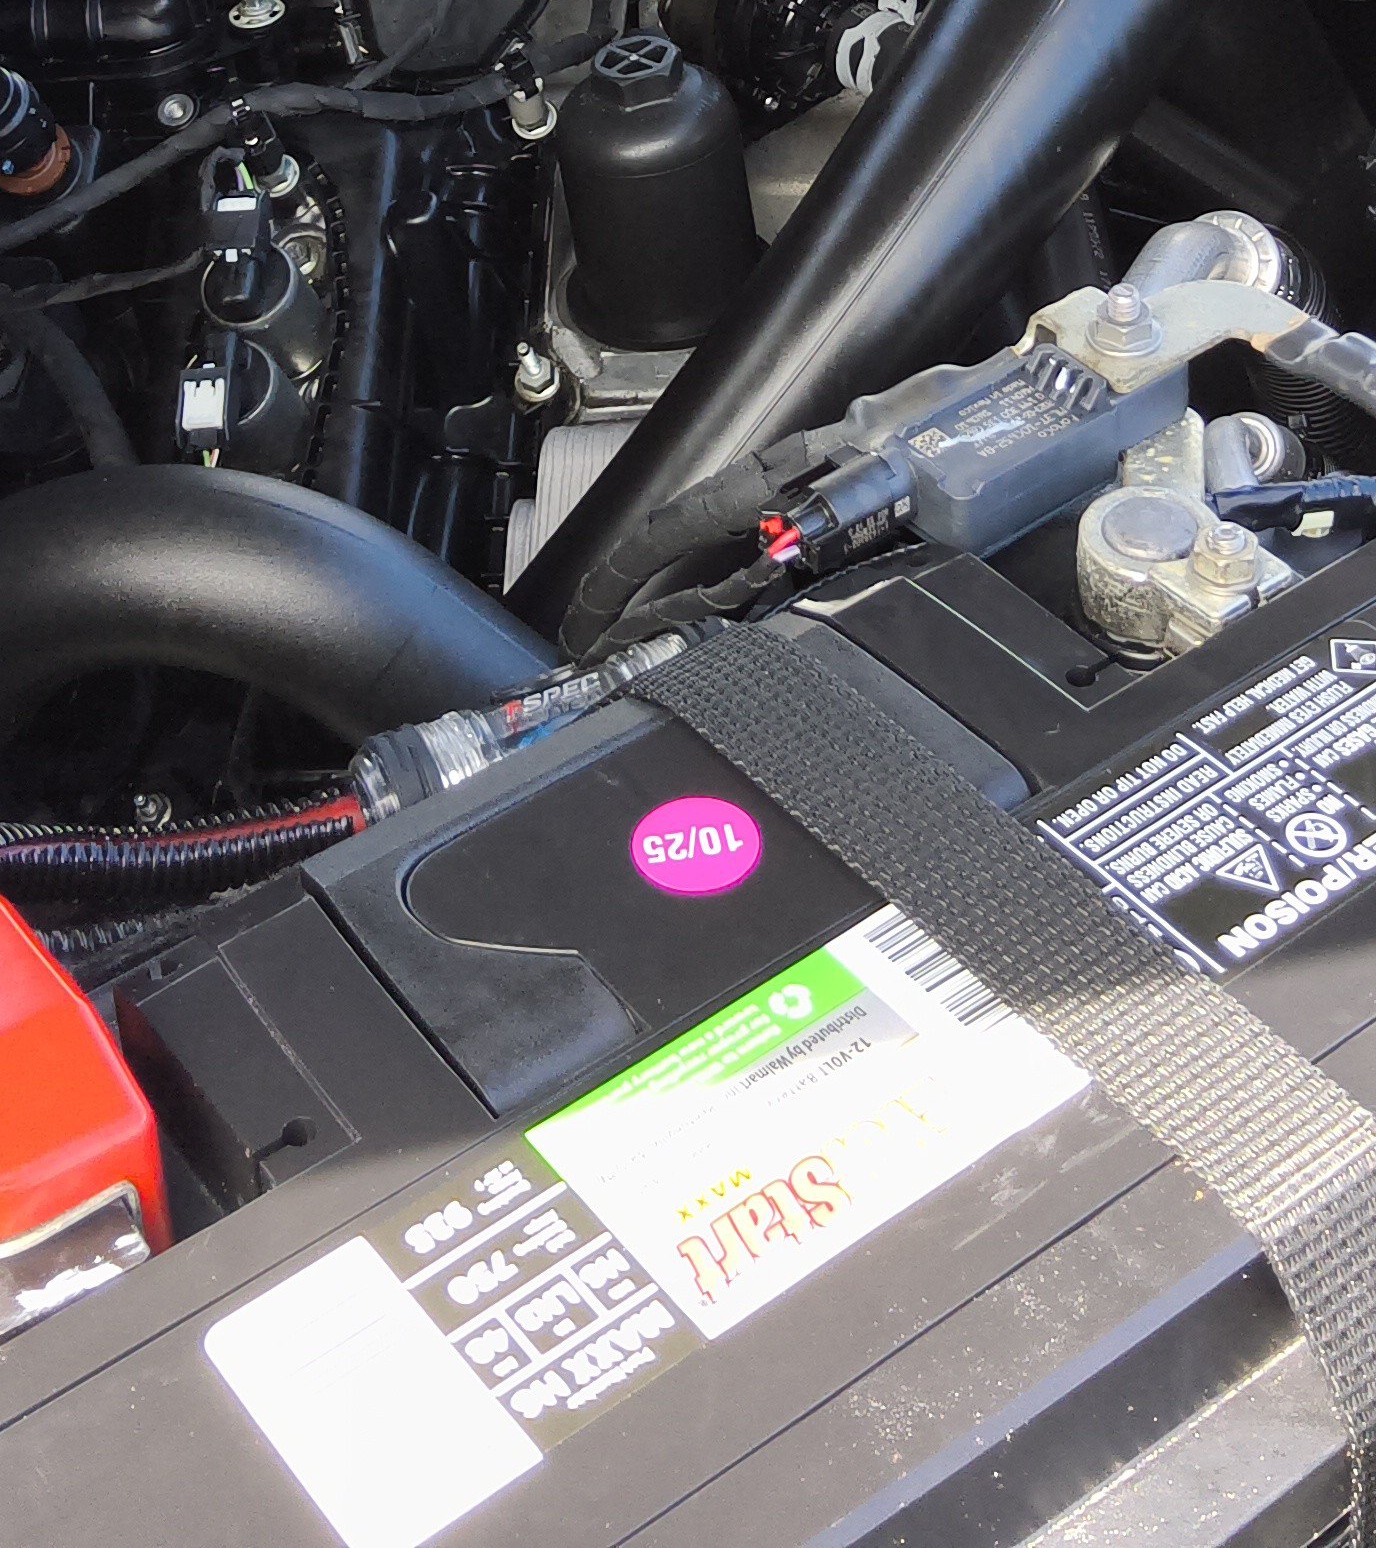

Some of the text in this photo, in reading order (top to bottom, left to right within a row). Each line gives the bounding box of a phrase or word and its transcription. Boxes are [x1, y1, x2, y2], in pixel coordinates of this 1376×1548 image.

[1189, 653, 1317, 737] GET MEDICAL HELP FAST.
[1263, 667, 1338, 718] WITH WATER.
[1221, 678, 1355, 767] FLUSH EYES IMMEDIATELY
[1323, 718, 1349, 737] OR
[1310, 746, 1342, 769] CAN
[1049, 741, 1188, 832] DO NOT TIP OR OPEN.
[1221, 760, 1284, 804] SMOKING
[1245, 773, 1301, 812] FLAMES
[1262, 785, 1318, 825] SPARKS
[1313, 792, 1345, 816] NO
[1076, 763, 1219, 857] READ INSTRUCTIONS.
[641, 822, 744, 864] 10/25
[1103, 800, 1219, 879] OR SEVERE BURNS.
[1123, 813, 1236, 889] CAUSE BLINDNESS
[1137, 825, 1256, 904] SULFURIC ACID CAN
[780, 1041, 808, 1062] by
[799, 1004, 869, 1052] Distributed
[738, 1053, 794, 1091] Walmart
[666, 1164, 759, 1227] MAXX
